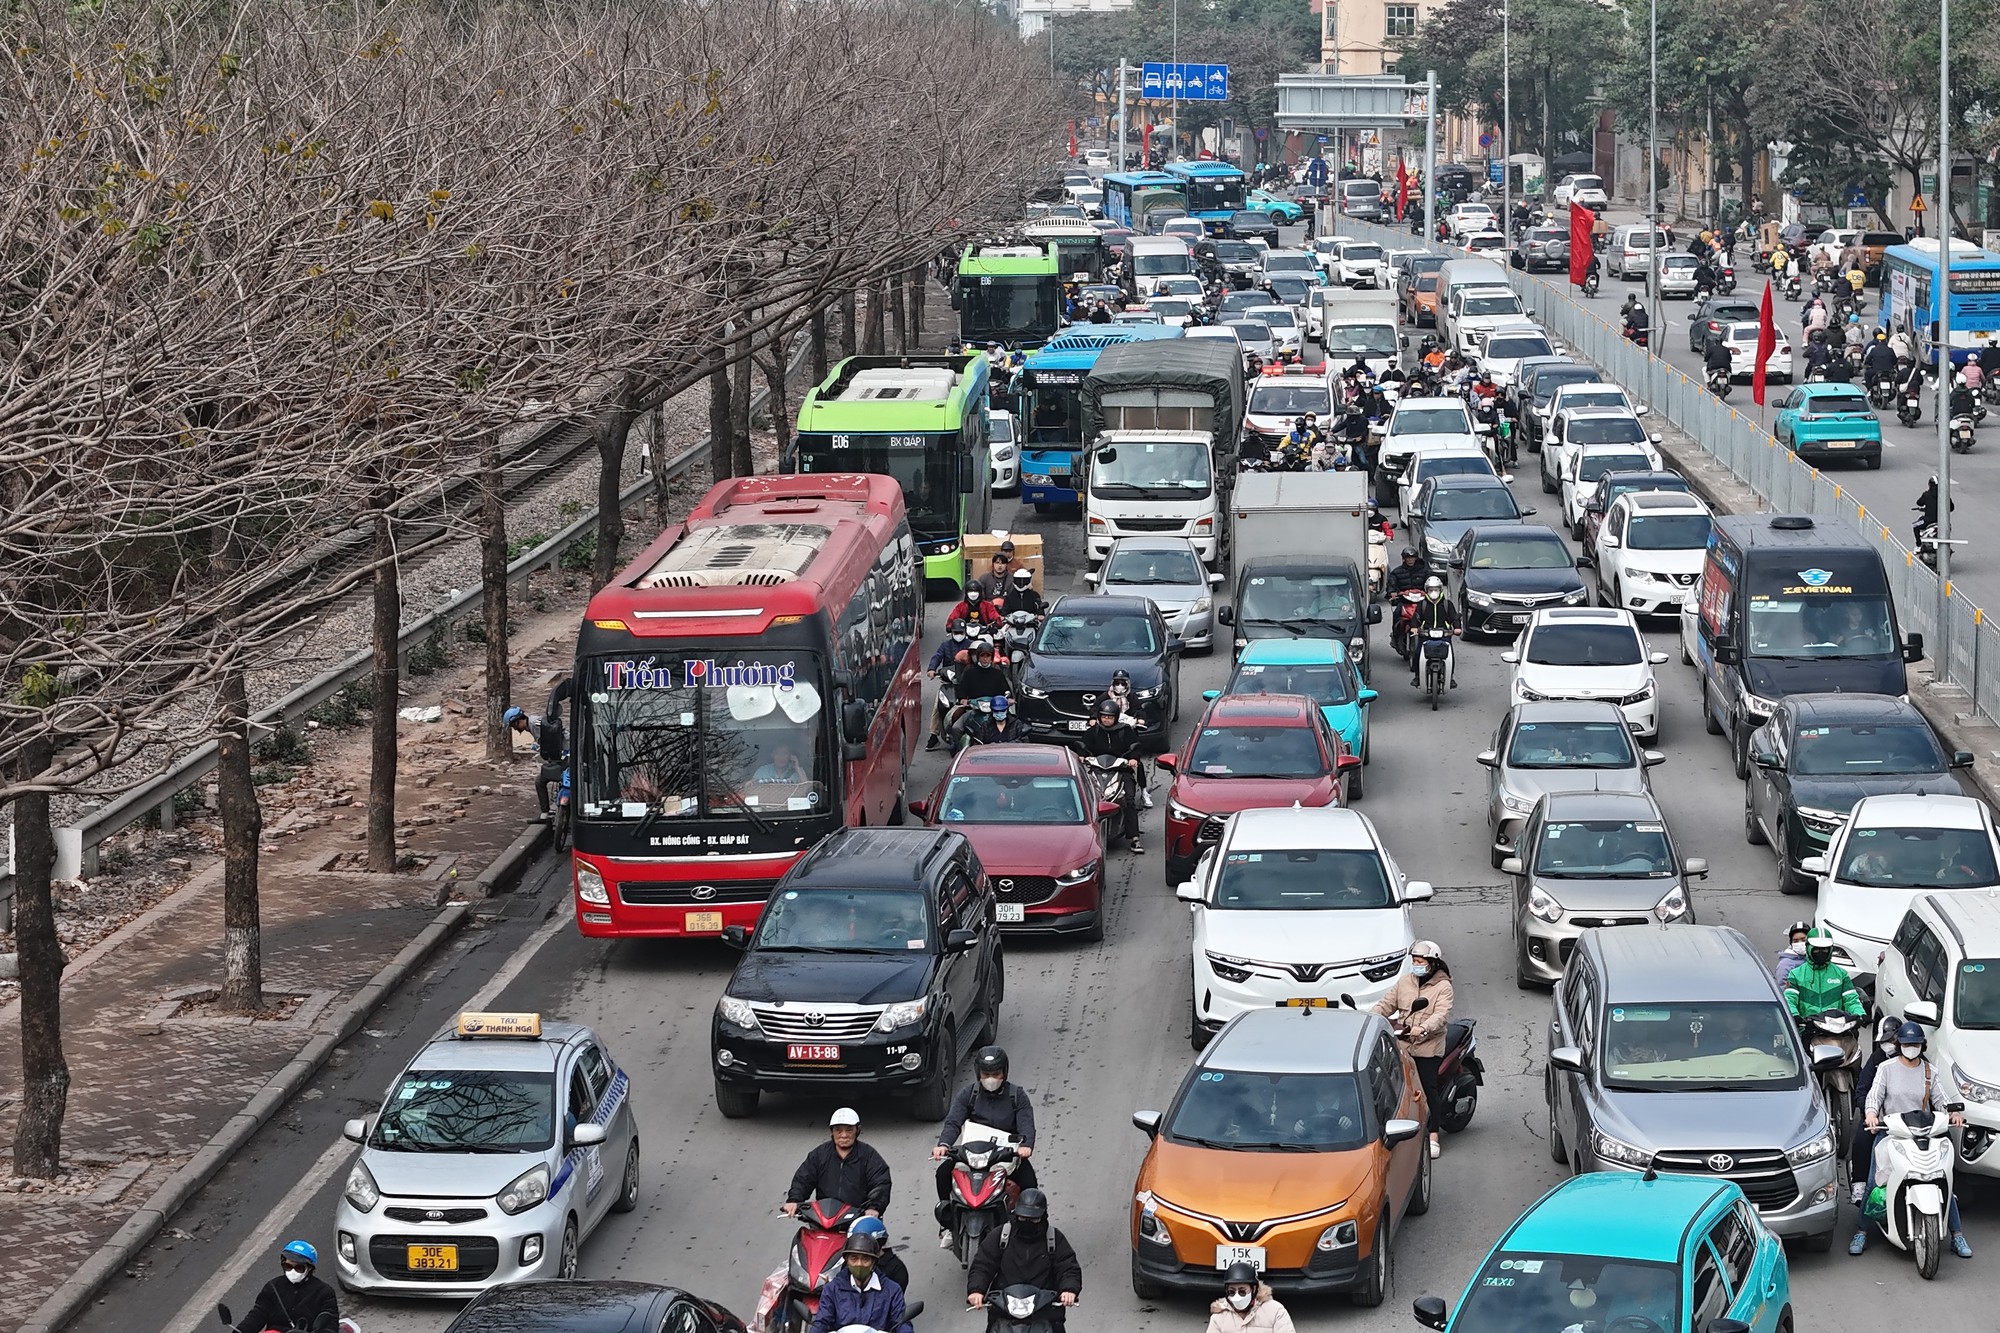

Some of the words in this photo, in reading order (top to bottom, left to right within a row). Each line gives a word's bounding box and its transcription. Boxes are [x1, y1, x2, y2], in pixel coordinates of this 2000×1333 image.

[1852, 273, 1862, 281] be
[832, 435, 849, 448] E06
[890, 436, 902, 446] BX
[1049, 466, 1070, 475] BUS
[604, 656, 672, 690] Tiến
[683, 659, 795, 692] Phương
[650, 837, 661, 845] BX.
[707, 836, 718, 844] BX.
[719, 834, 735, 844] GIÁP
[736, 833, 750, 844] BÁT
[998, 904, 1014, 912] 30H
[696, 913, 712, 921] 36B
[690, 922, 719, 930] 016.39
[1298, 998, 1316, 1007] 29E
[485, 1025, 513, 1033] THANH
[515, 1025, 532, 1033] NGA
[790, 1046, 838, 1058] AV-13-88
[886, 1045, 908, 1055] 11-VP
[421, 1247, 443, 1257] 30E
[1231, 1247, 1251, 1258] 15K
[414, 1258, 451, 1269] 383.21
